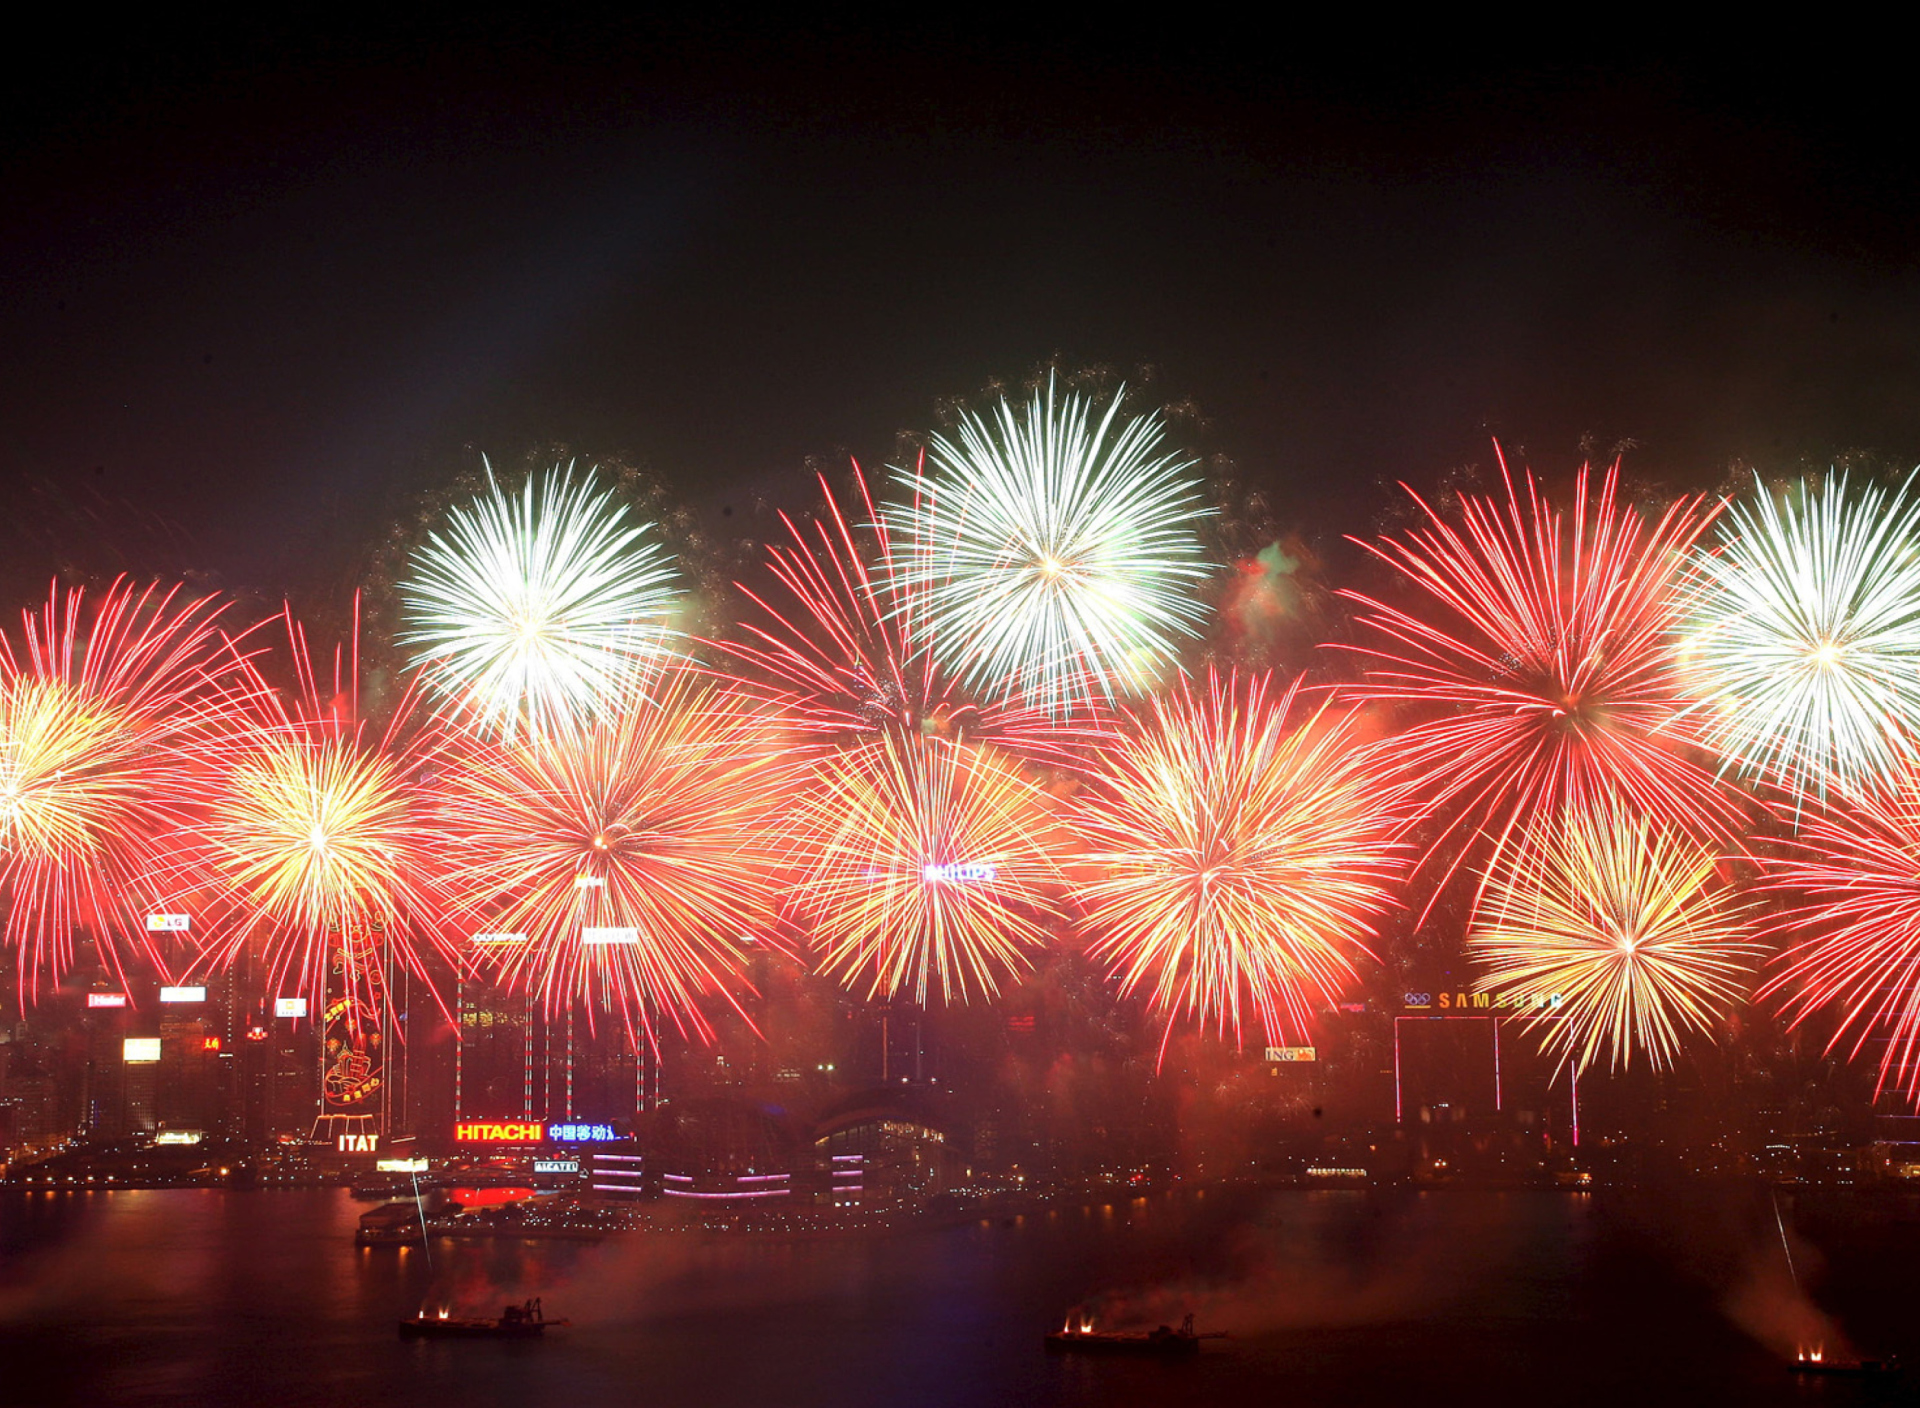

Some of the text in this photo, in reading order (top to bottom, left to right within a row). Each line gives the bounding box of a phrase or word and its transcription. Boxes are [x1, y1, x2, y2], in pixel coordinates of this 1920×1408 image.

[167, 918, 183, 927] LG
[1438, 992, 1563, 1009] SAMSUNG
[1267, 1050, 1294, 1060] ING
[457, 1124, 541, 1140] HITACHI
[338, 1134, 379, 1152] ITAT
